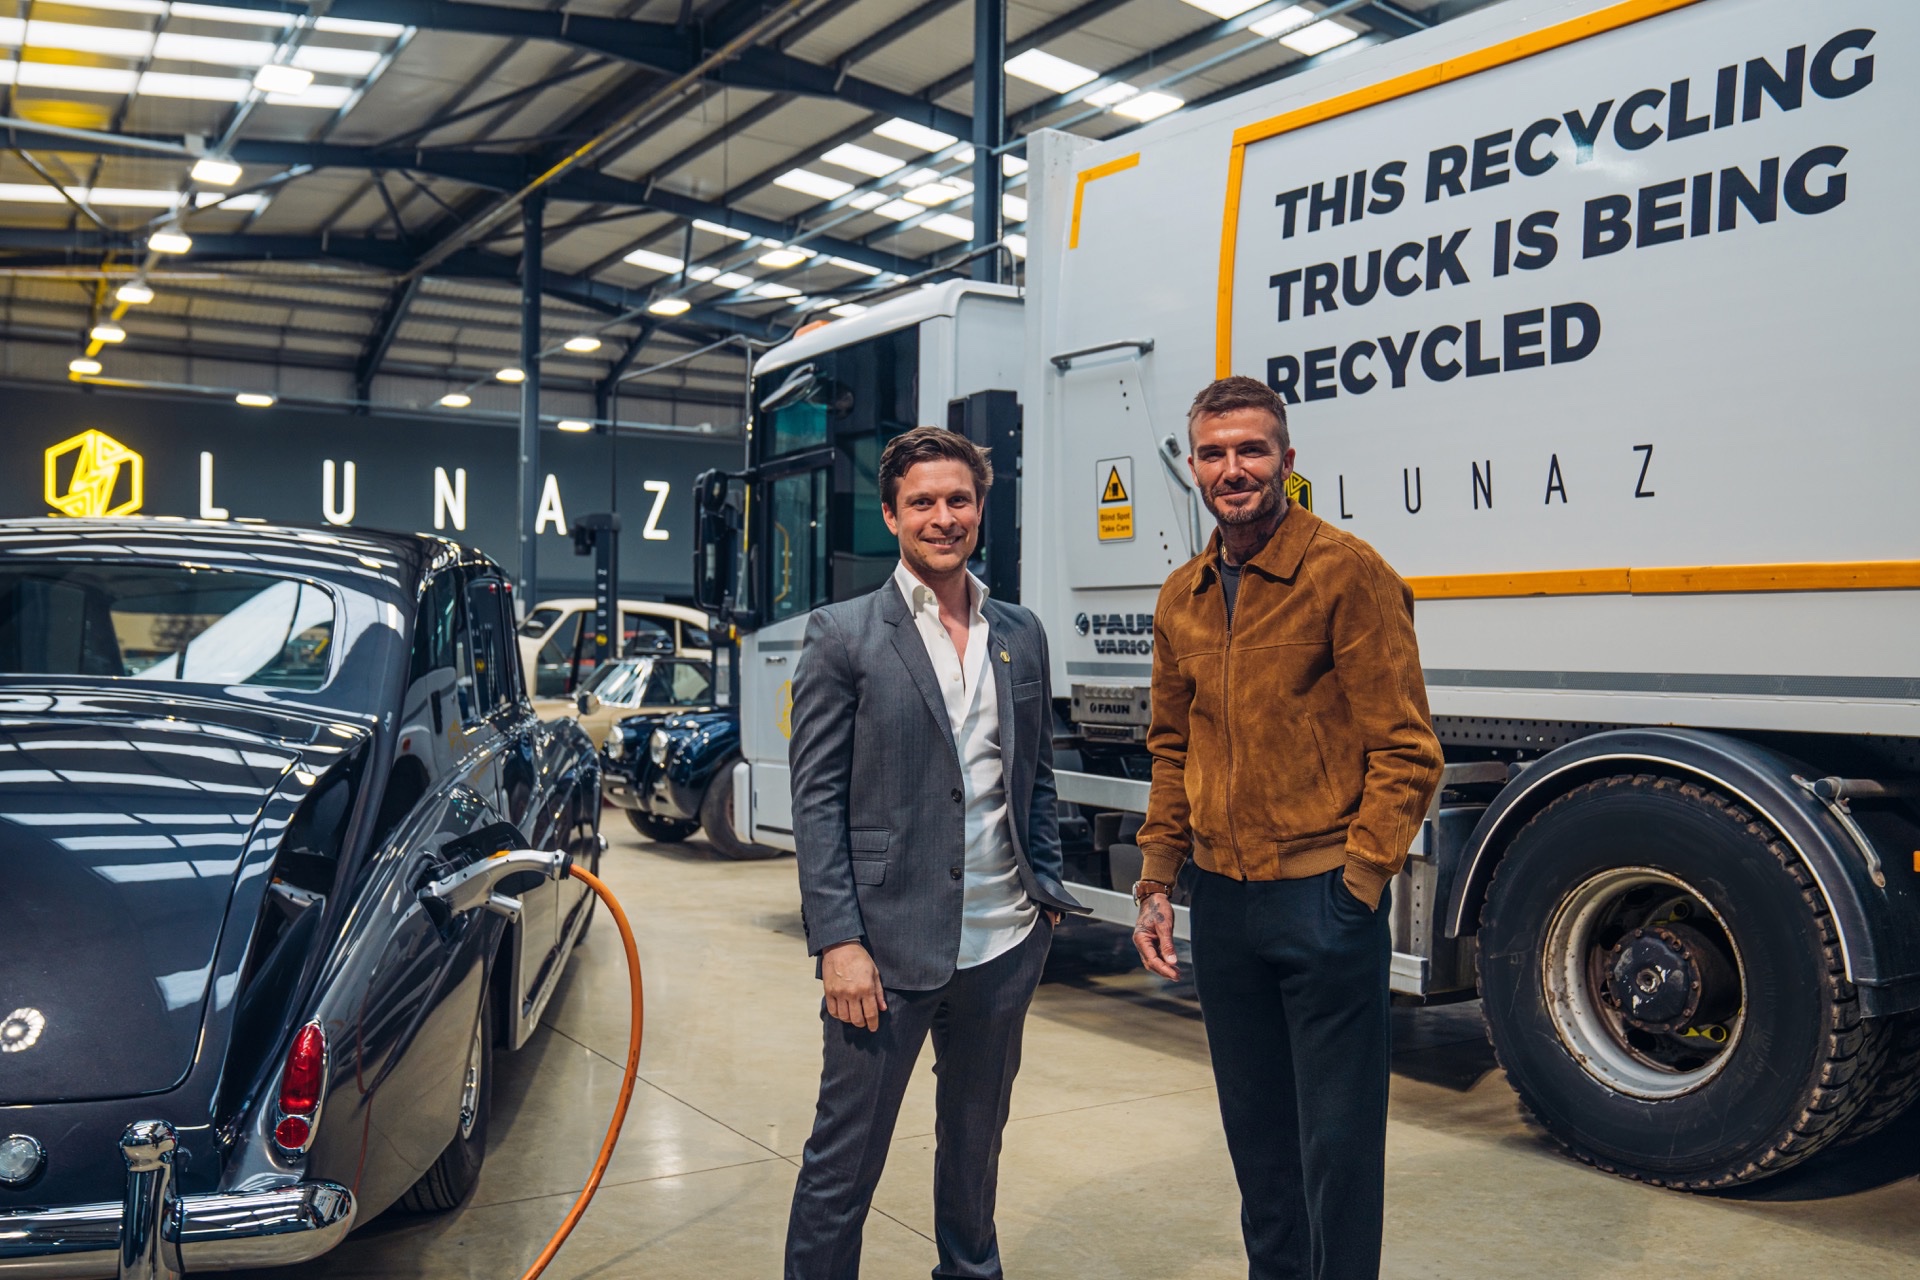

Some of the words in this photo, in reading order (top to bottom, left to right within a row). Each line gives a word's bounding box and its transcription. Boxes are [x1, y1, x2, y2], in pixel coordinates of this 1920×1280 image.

[1275, 160, 1408, 240] THIS
[1425, 28, 1877, 204] RECYCLING
[1269, 228, 1472, 323] TRUCK
[1493, 210, 1560, 278] IS
[1582, 145, 1849, 260] BEING
[1267, 301, 1601, 405] RECYCLED
[199, 451, 671, 541] LUNAZ
[1100, 514, 1115, 522] Blind
[1116, 512, 1130, 521] Spot
[1338, 443, 1656, 520] LUNAZ
[1101, 524, 1115, 532] Take
[1116, 523, 1130, 532] Care
[1094, 639, 1154, 655] VARIO
[1098, 703, 1130, 714] FAUN
